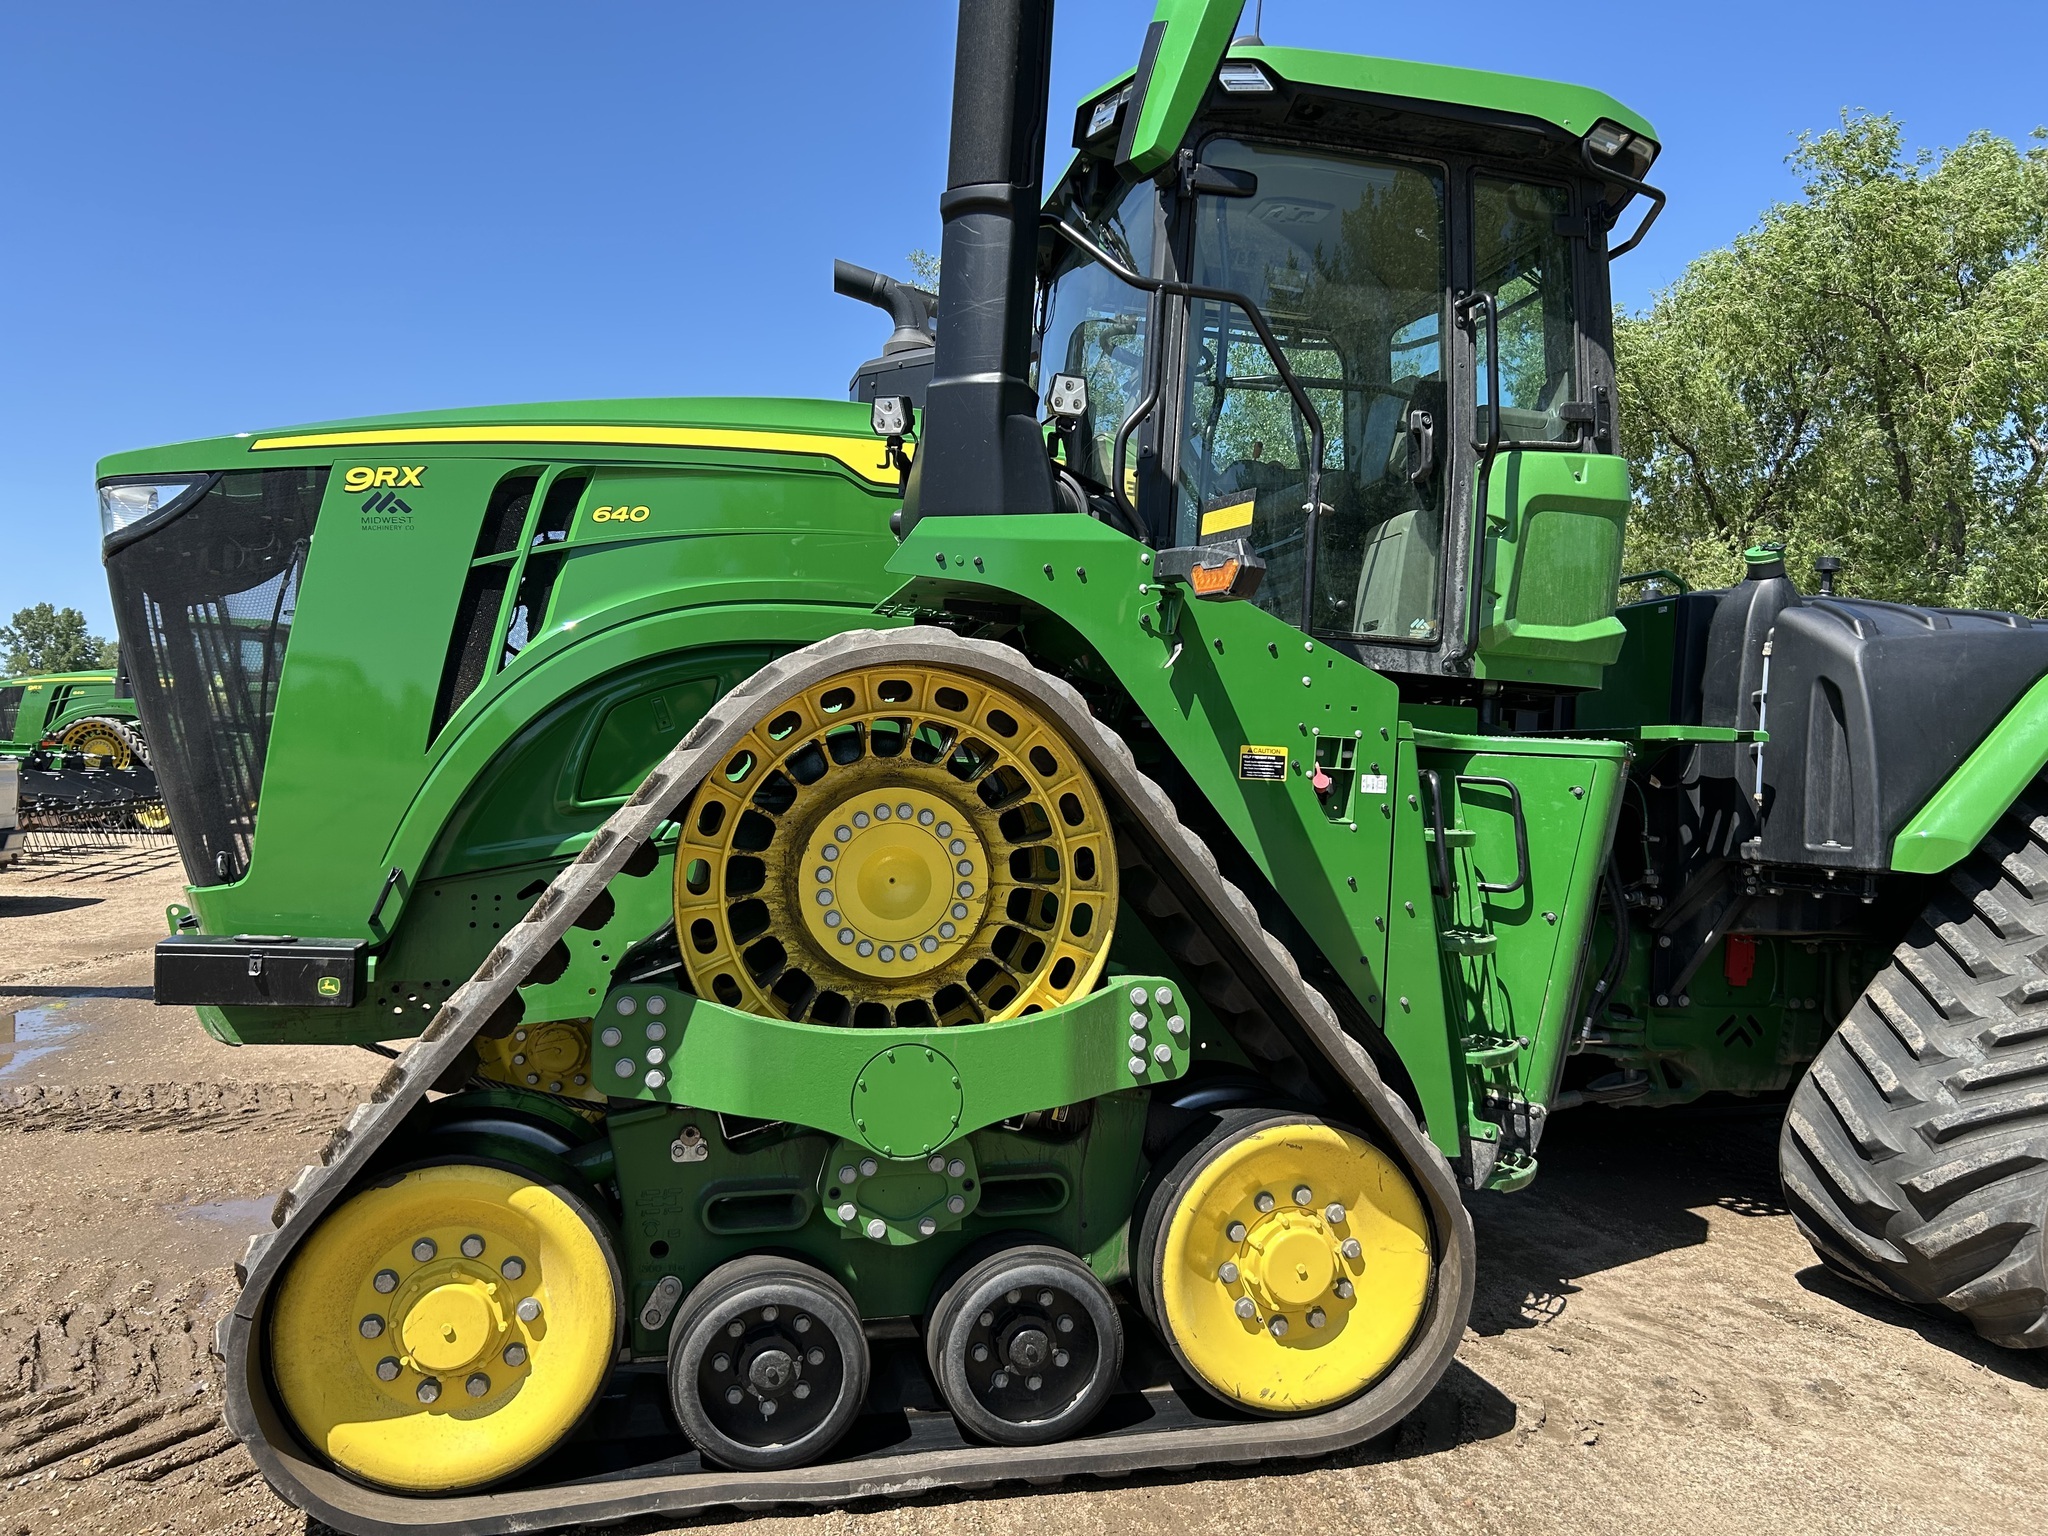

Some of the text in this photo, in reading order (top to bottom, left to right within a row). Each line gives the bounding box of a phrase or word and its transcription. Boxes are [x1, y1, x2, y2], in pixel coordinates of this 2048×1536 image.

[343, 466, 428, 493] 9RX
[361, 516, 414, 524] MIDWEST
[592, 505, 651, 523] 640
[1253, 747, 1281, 755] CAUTION
